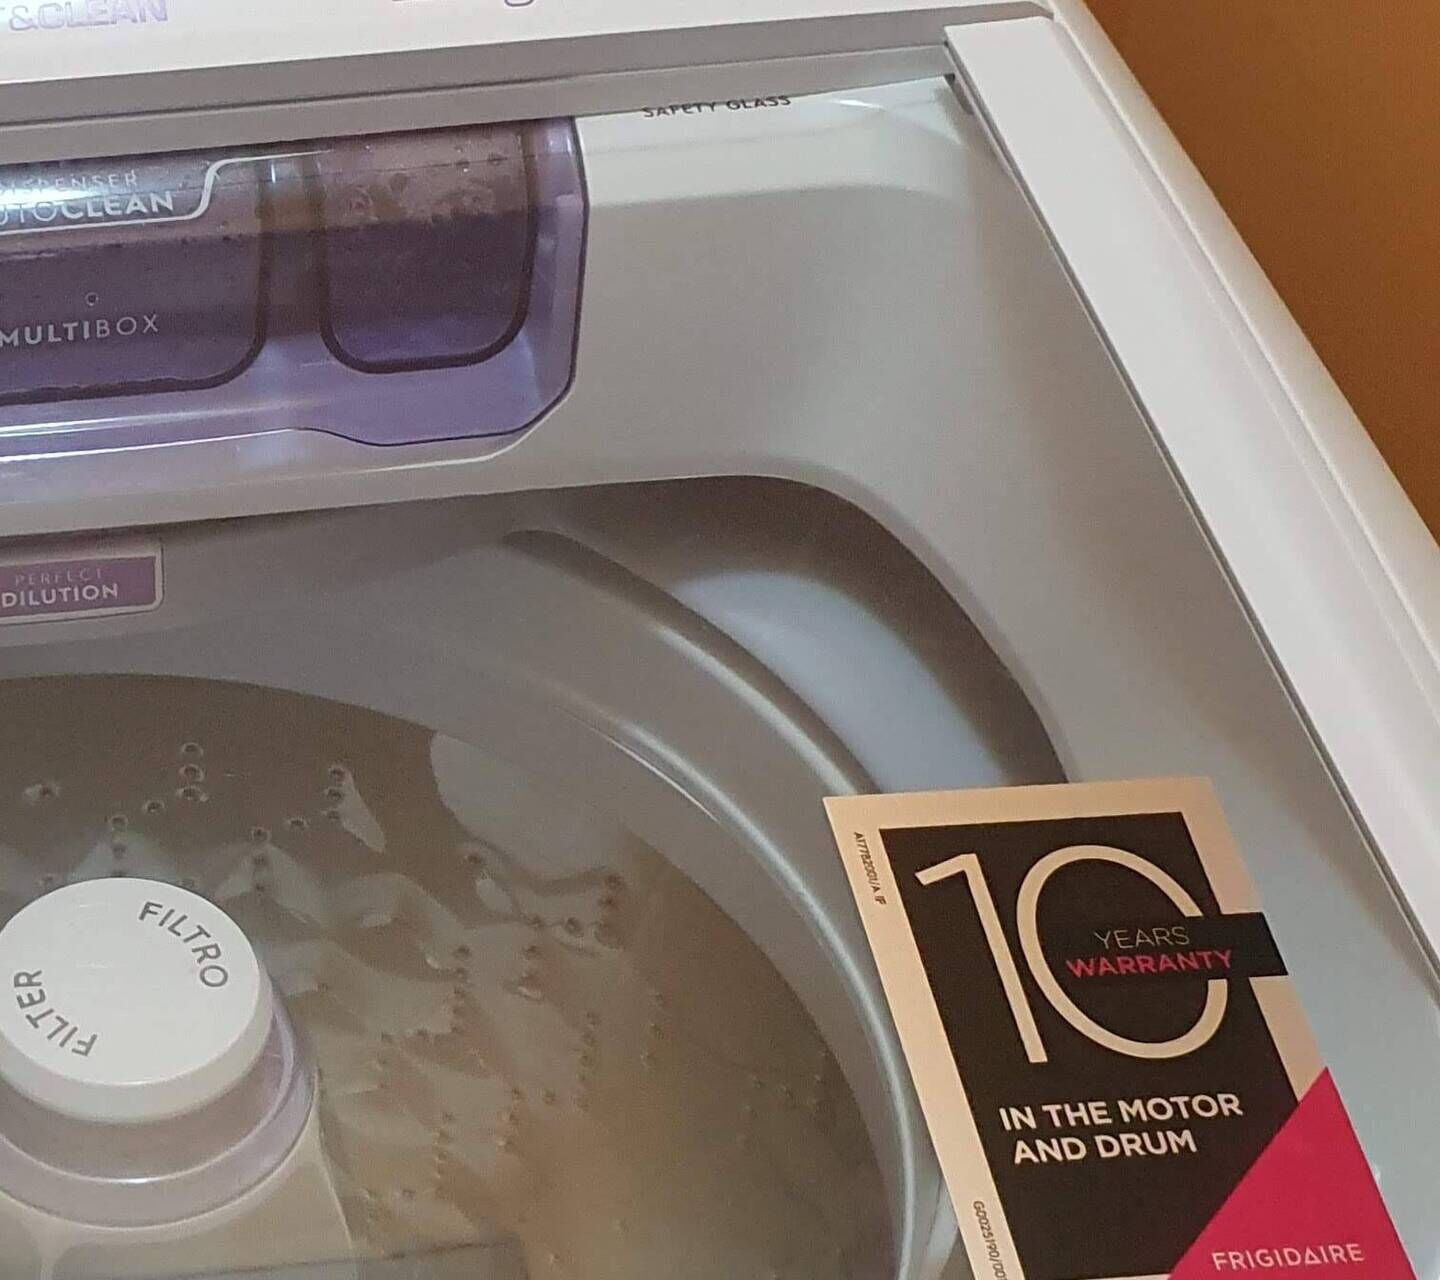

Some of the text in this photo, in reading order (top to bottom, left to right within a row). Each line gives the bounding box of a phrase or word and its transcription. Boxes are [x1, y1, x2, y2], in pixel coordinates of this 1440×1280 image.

[642, 95, 791, 119] SAFETY GLASS
[15, 568, 103, 586] PERFECT
[1, 583, 118, 608] DILUTION
[138, 901, 228, 987] FILTRO
[1095, 926, 1190, 949] YEARS
[915, 844, 1228, 1063] 10
[1066, 950, 1232, 979] WARRANTY
[14, 970, 97, 1056] FILTER
[999, 1093, 1243, 1131] IN THE MOTOR
[1013, 1130, 1197, 1165] AND DRUM
[1212, 1242, 1365, 1271] FRIGIDAIRE
